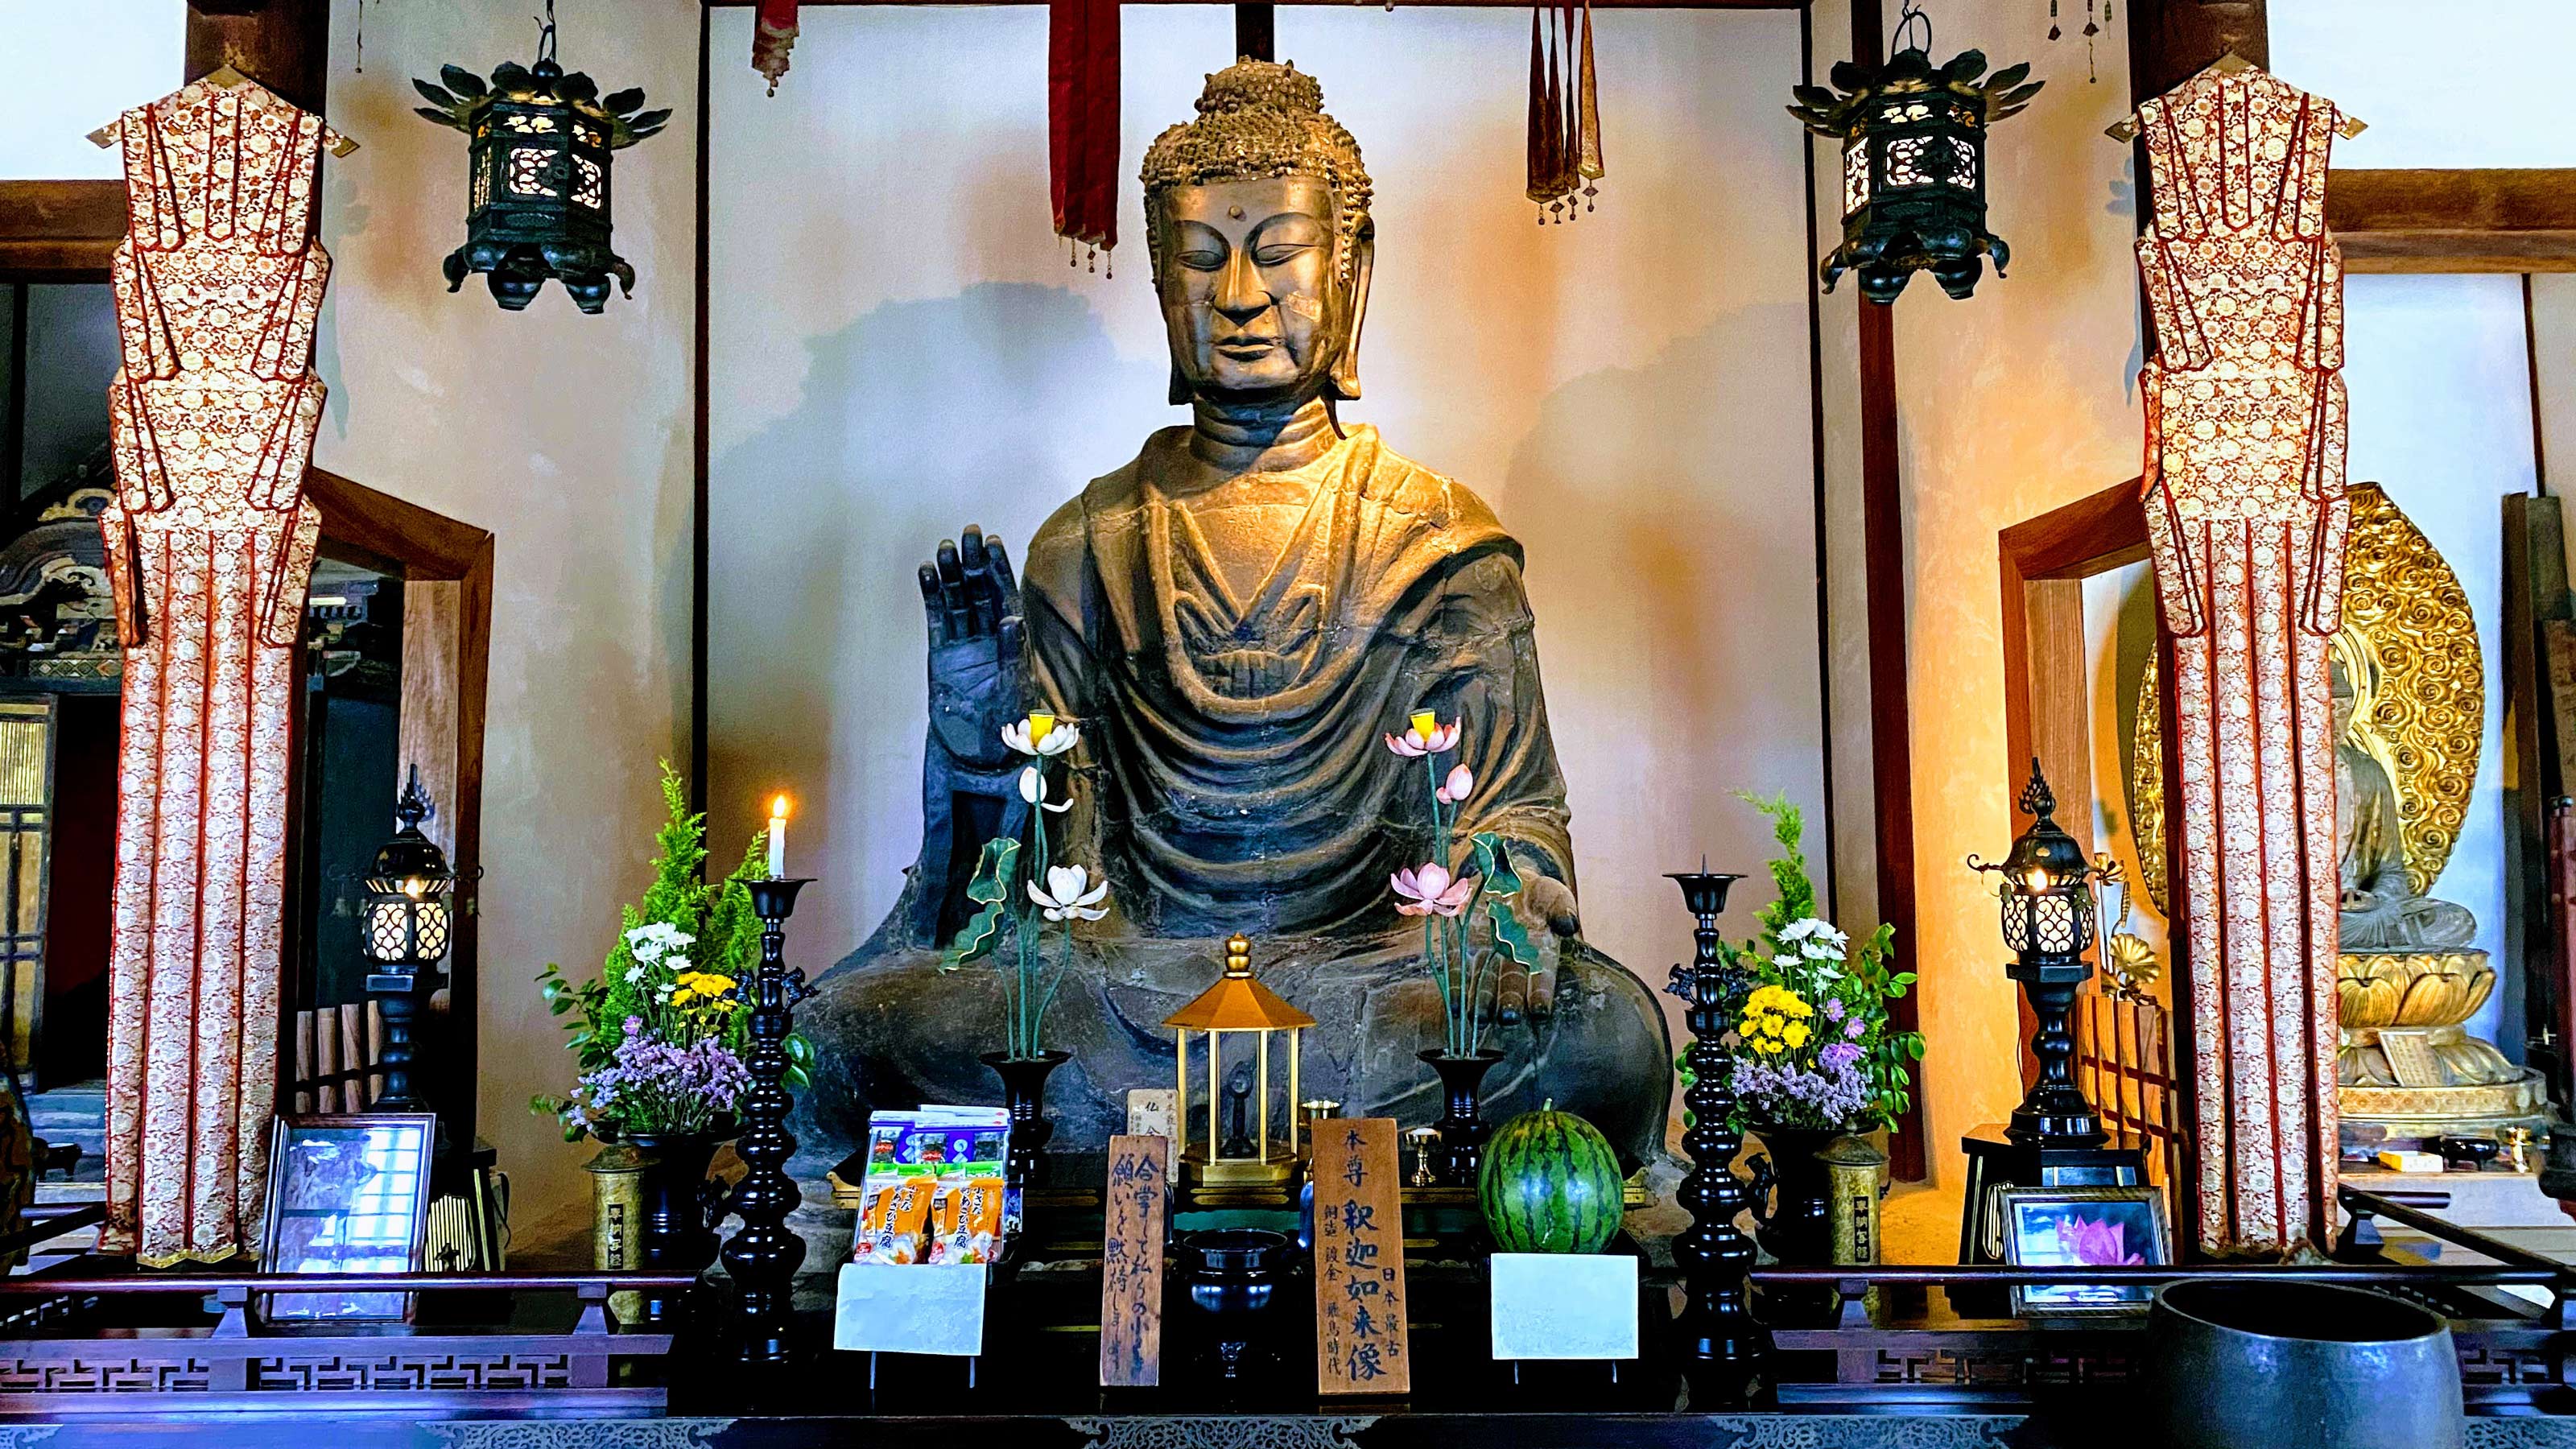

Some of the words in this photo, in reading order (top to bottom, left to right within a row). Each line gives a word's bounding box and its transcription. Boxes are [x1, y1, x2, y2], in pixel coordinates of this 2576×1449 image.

[1343, 1129, 1368, 1187] 本尊
[972, 1187, 985, 1216] 小さな
[1342, 1199, 1388, 1381] 釈迦如来像
[1381, 1267, 1400, 1358] 日本最古
